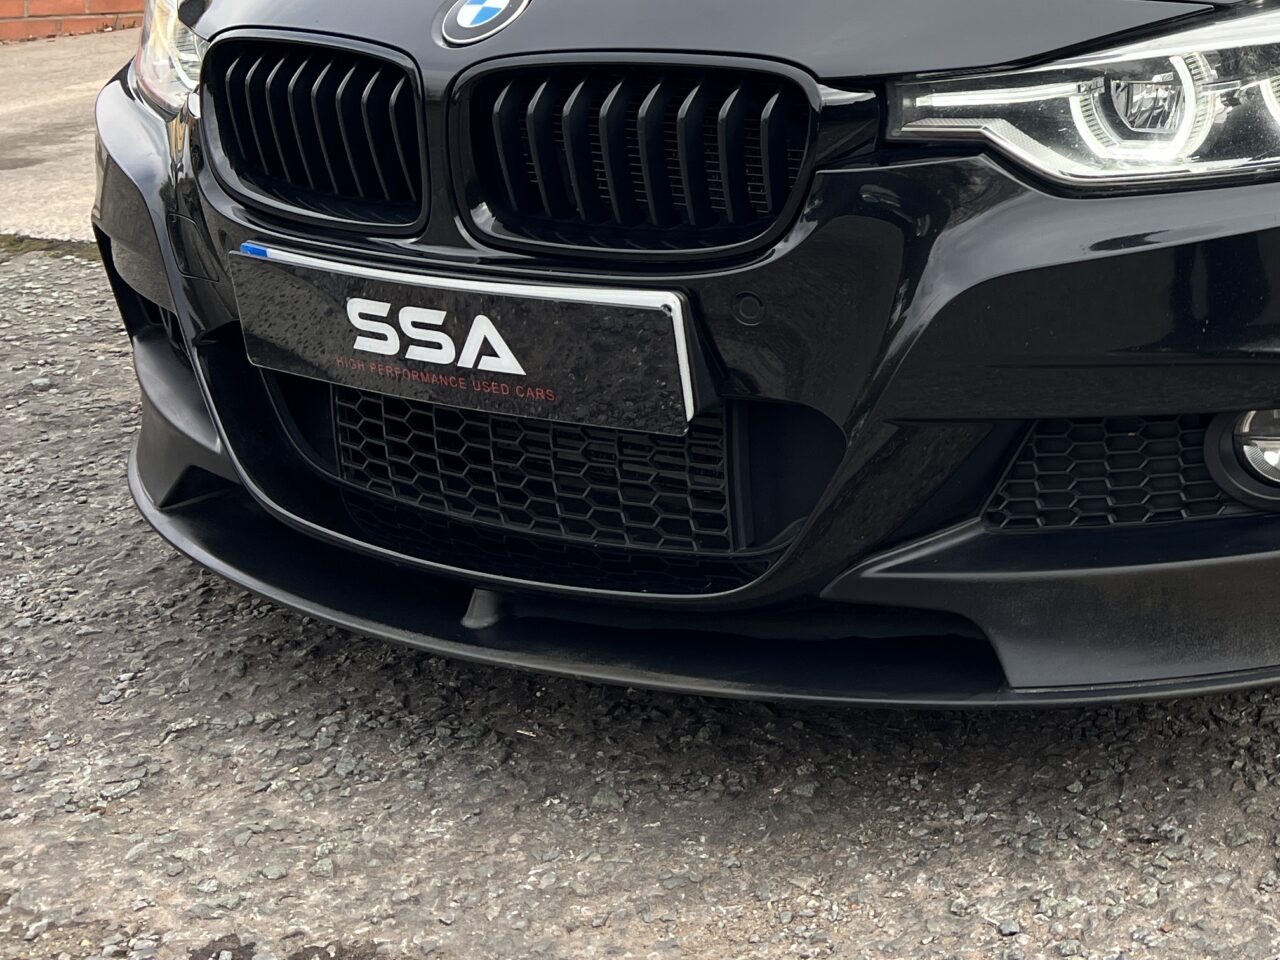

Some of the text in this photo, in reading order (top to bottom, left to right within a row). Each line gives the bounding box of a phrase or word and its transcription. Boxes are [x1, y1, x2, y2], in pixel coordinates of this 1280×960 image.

[346, 298, 527, 376] SSA
[336, 356, 556, 401] HIGH PERFORMANCE USED CARS
